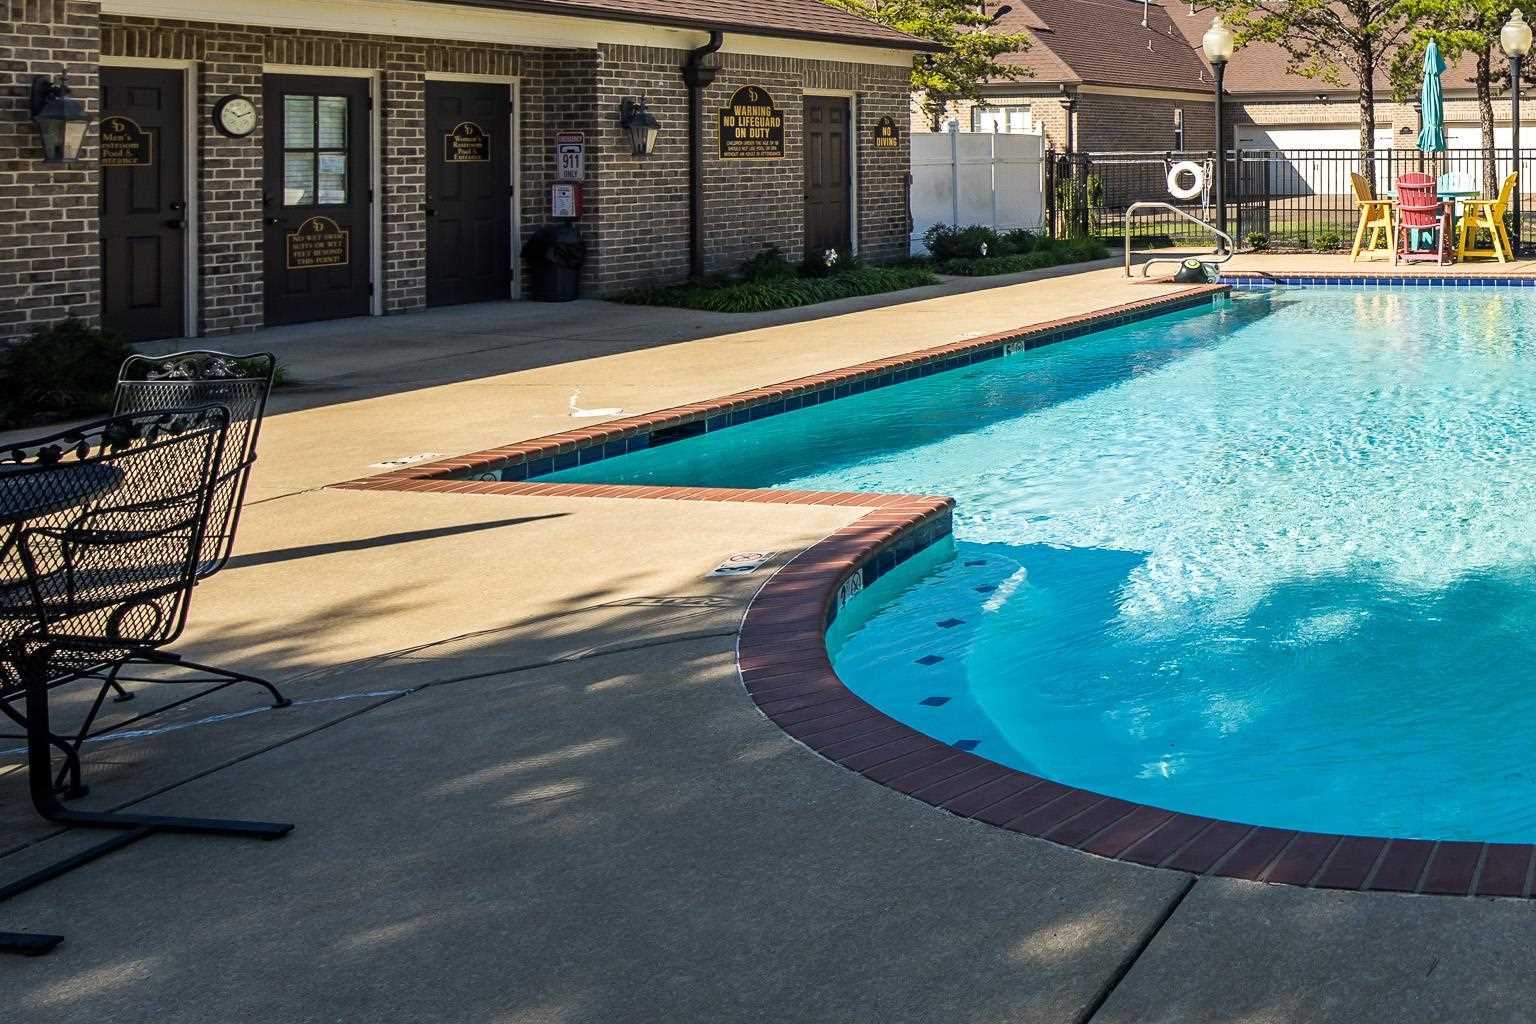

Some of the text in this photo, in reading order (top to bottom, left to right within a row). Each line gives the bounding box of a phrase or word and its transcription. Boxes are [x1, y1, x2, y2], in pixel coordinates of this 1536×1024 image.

[734, 105, 771, 116] WARNING
[723, 116, 781, 128] NO LIFEGUARD
[735, 127, 769, 138] ON DUTY
[882, 127, 892, 136] NO
[876, 137, 898, 147] DIVING
[562, 154, 580, 169] 911
[563, 170, 578, 178] ONLY
